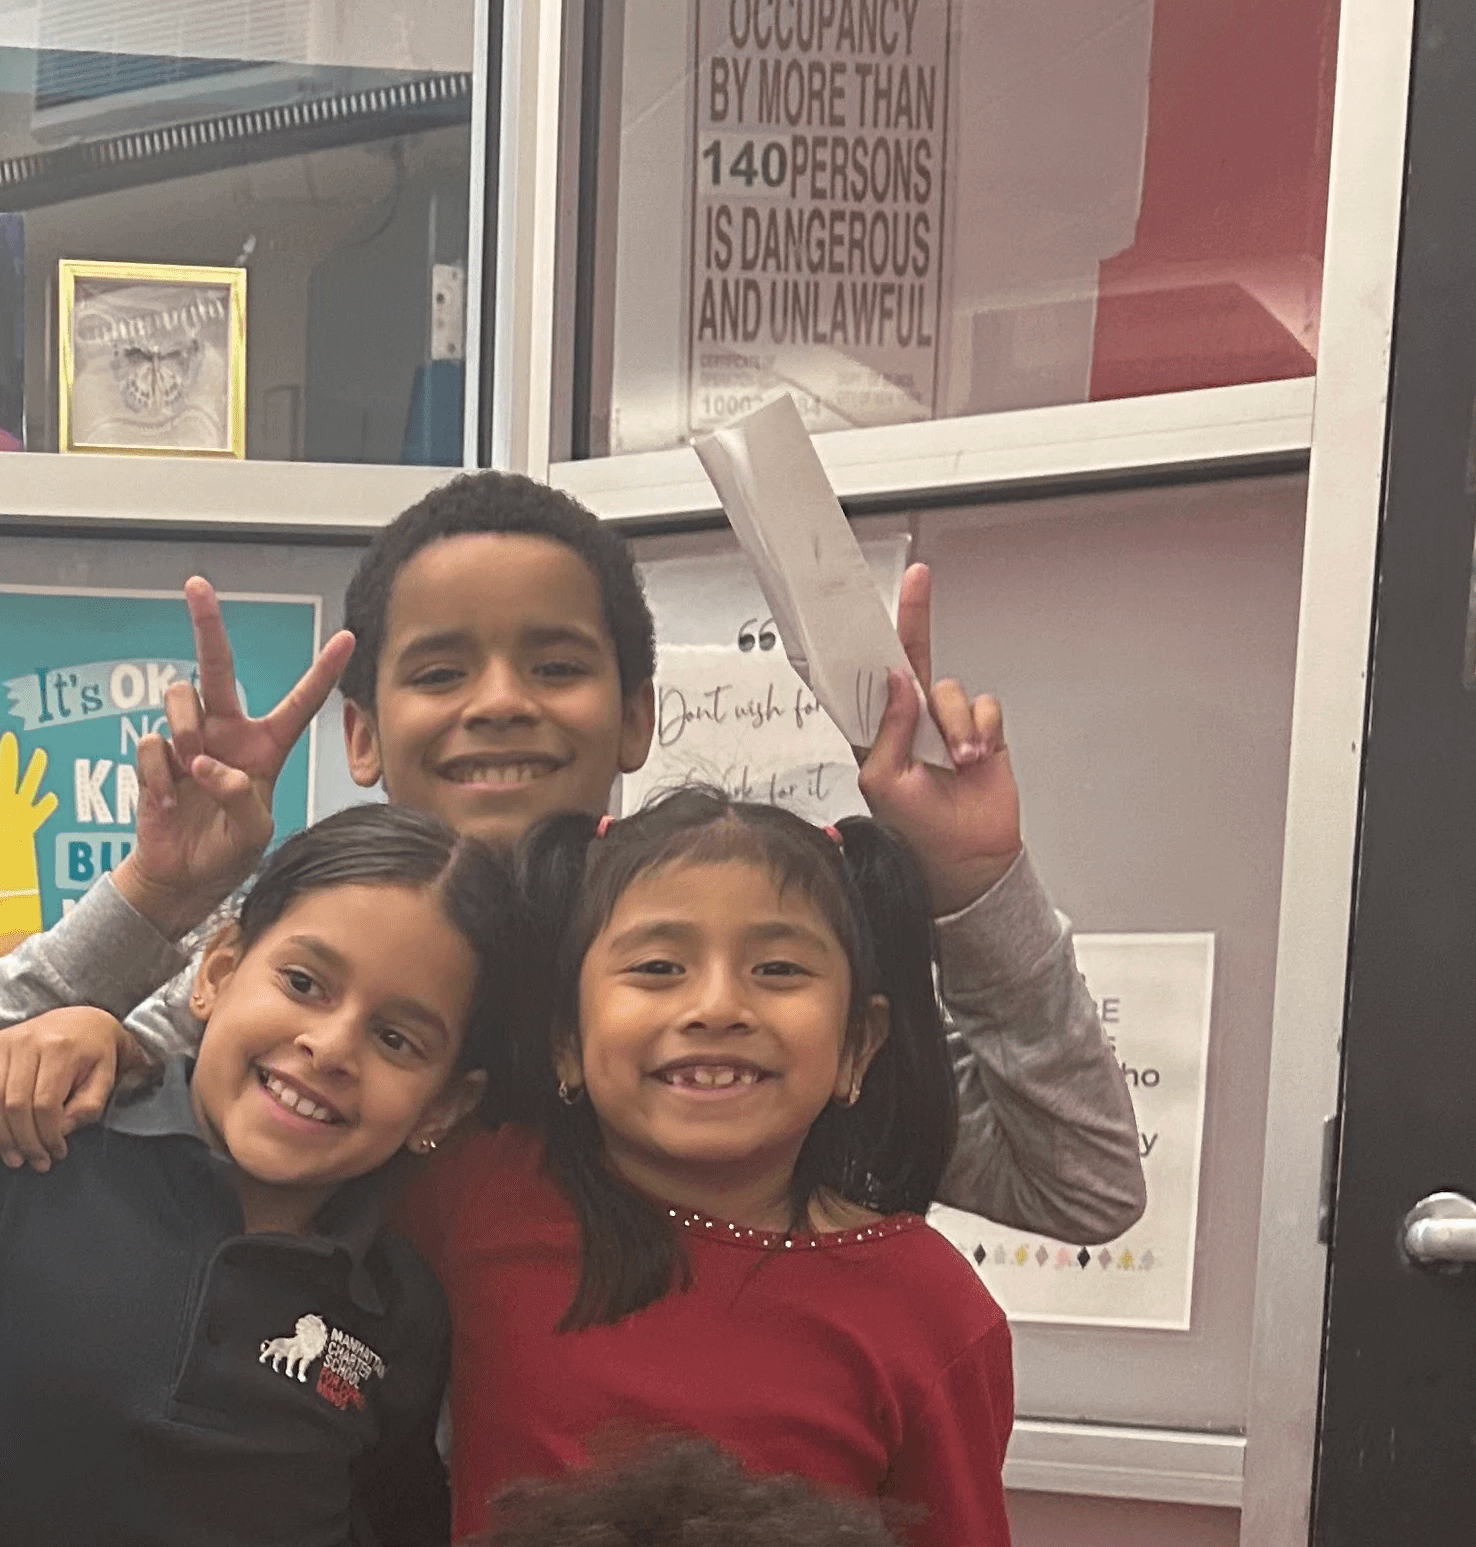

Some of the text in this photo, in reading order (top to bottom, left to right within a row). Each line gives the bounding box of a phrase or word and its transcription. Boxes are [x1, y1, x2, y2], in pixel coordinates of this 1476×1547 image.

[730, 0, 918, 54] OCCUPANCY
[710, 57, 936, 131] BY MORE THAN
[702, 134, 933, 204] 140 PERSONS
[705, 204, 932, 278] IS DANGEROUS
[698, 278, 933, 349] AND UNLAWFUL
[35, 663, 176, 724] It's OK
[735, 683, 786, 729] wish
[807, 762, 830, 802] it
[323, 1353, 360, 1390] SCHOOL
[327, 1341, 372, 1381] CHARTER
